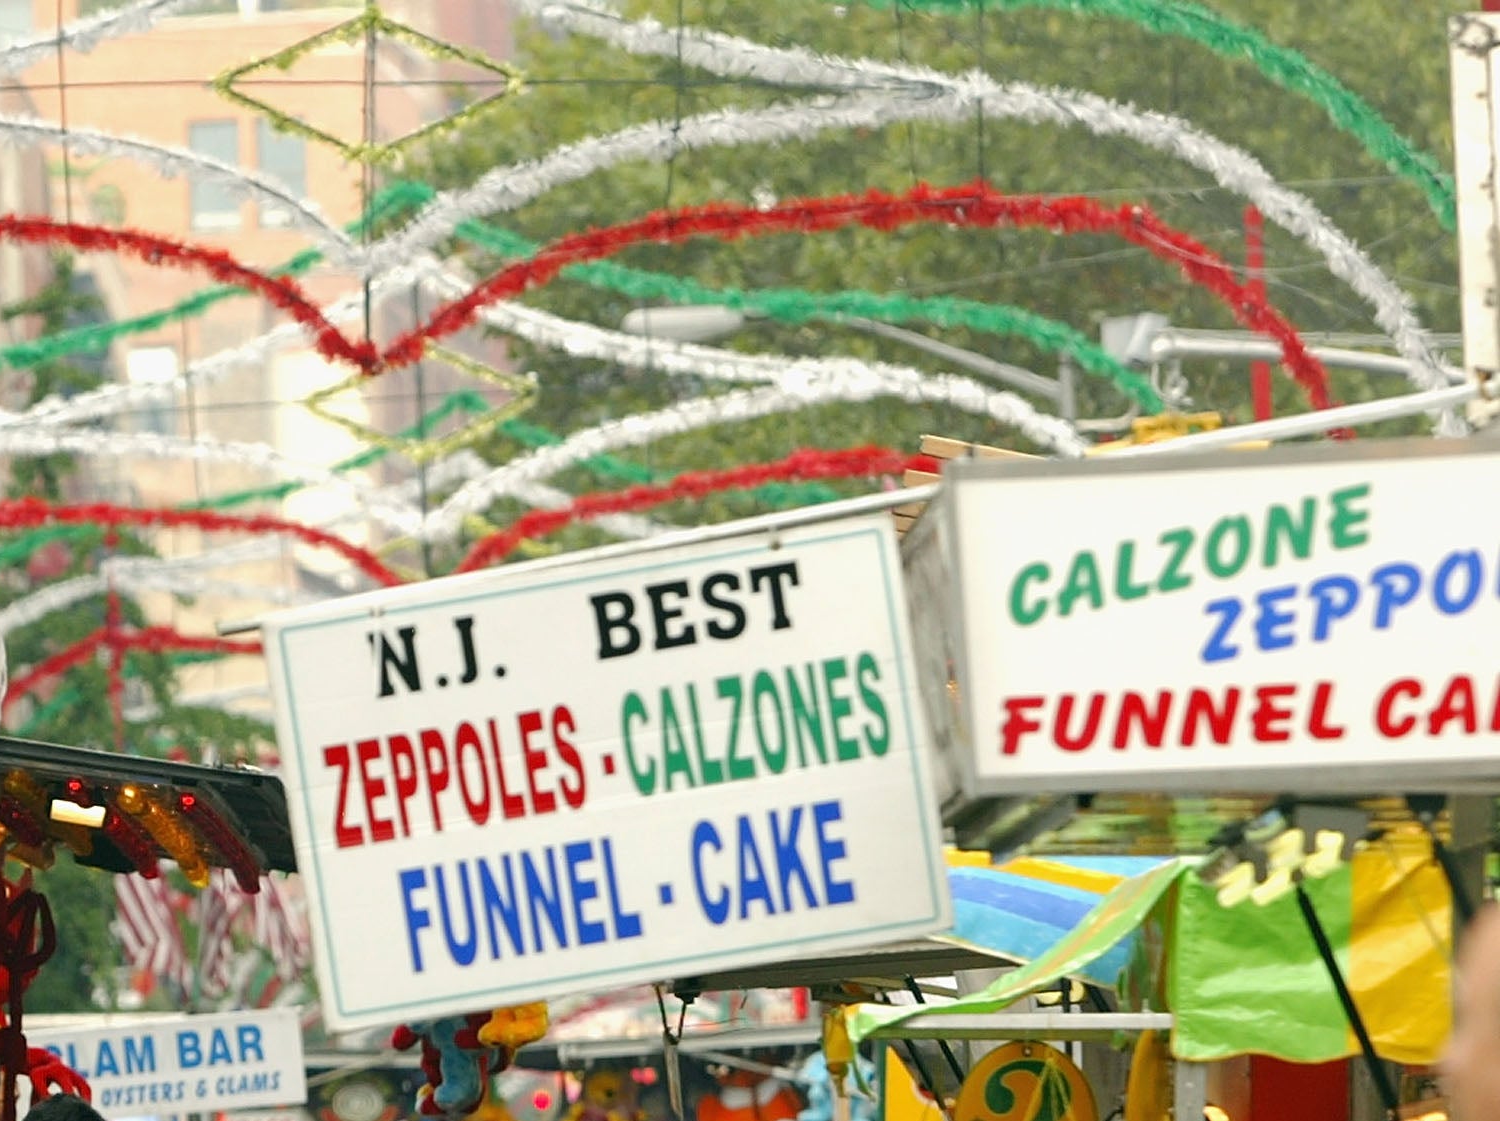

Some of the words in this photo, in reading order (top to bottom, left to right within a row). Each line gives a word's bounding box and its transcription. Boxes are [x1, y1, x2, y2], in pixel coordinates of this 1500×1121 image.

[1008, 483, 1371, 626] CALZONE
[1200, 548, 1500, 664] ZEPPO
[367, 616, 508, 699] N.J.
[589, 560, 801, 660] BEST
[323, 705, 587, 849] ZEPPOLES
[620, 651, 891, 796] CALZONES
[1000, 682, 1346, 757] FUNNEL
[398, 837, 643, 973] FUNNEL
[690, 801, 855, 924] CAKE
[101, 1080, 185, 1107] OYSTERS
[215, 1071, 281, 1096] CLAMS
[176, 1024, 265, 1070] BAR
